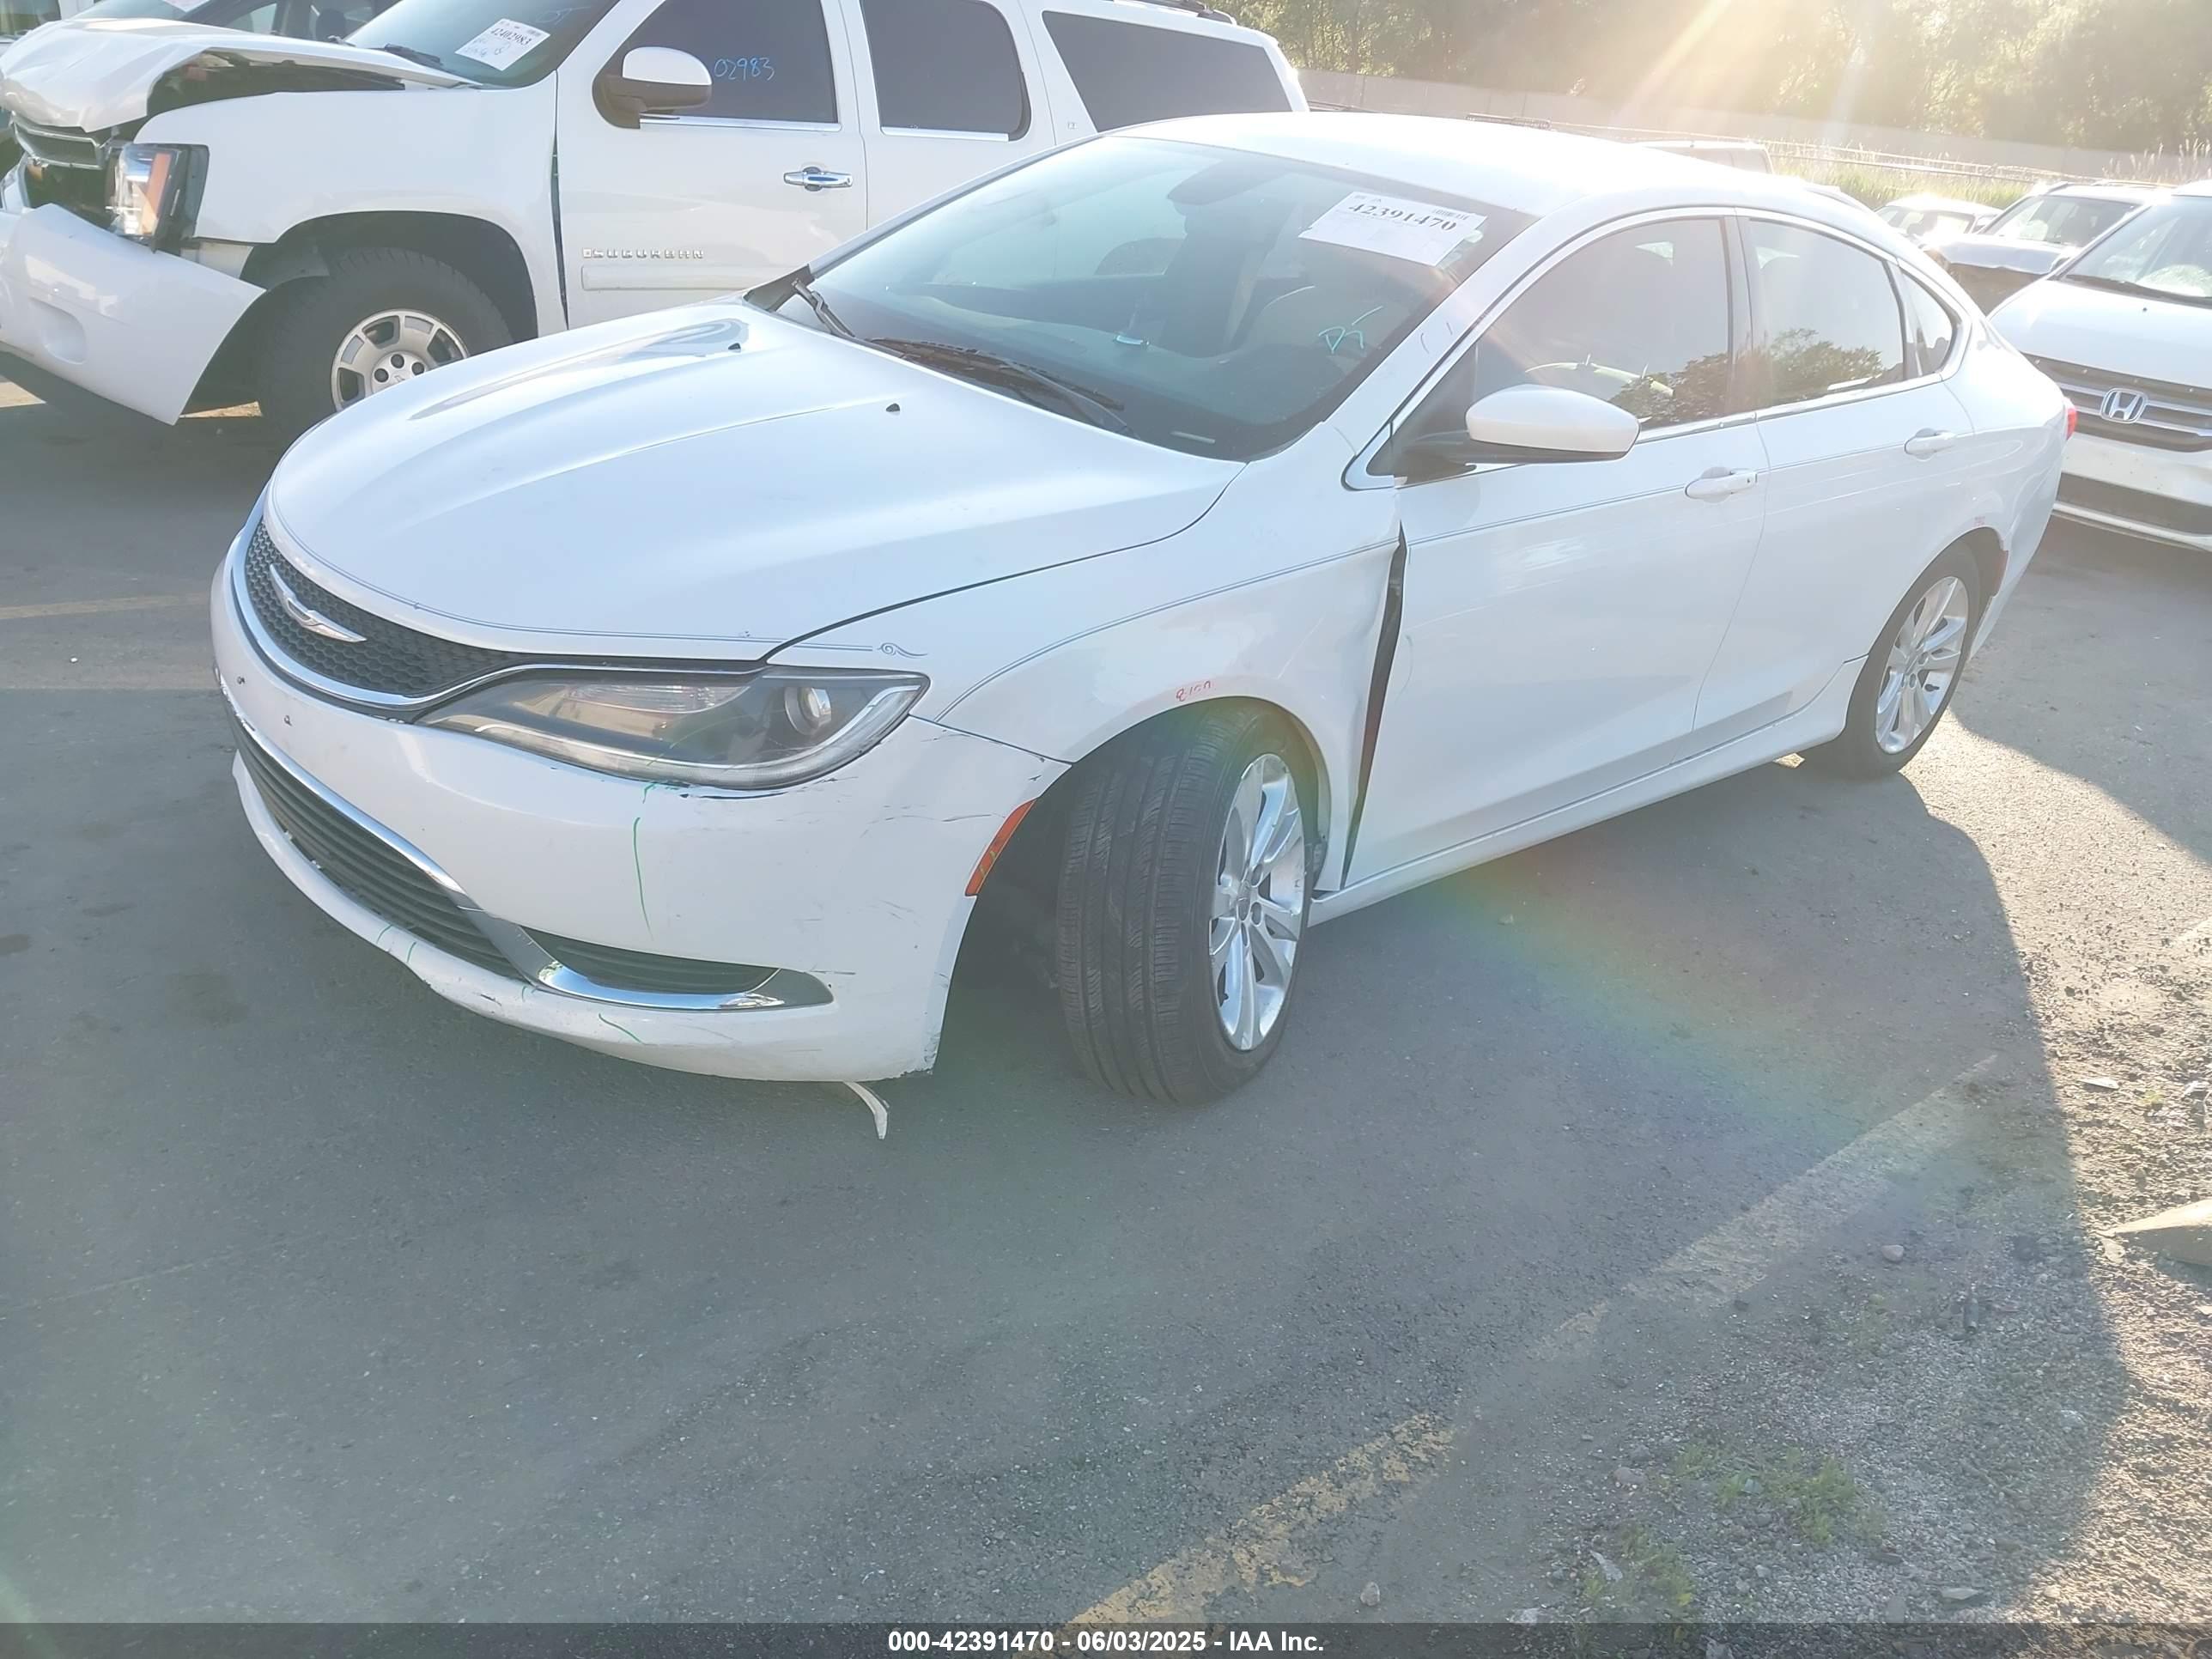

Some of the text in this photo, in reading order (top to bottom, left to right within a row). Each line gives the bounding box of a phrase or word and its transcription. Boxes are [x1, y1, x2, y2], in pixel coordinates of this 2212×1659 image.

[490, 27, 532, 46] 42402983
[714, 58, 775, 81] 02983
[1348, 203, 1457, 232] 42391470
[592, 247, 704, 258] SUBURBAN
